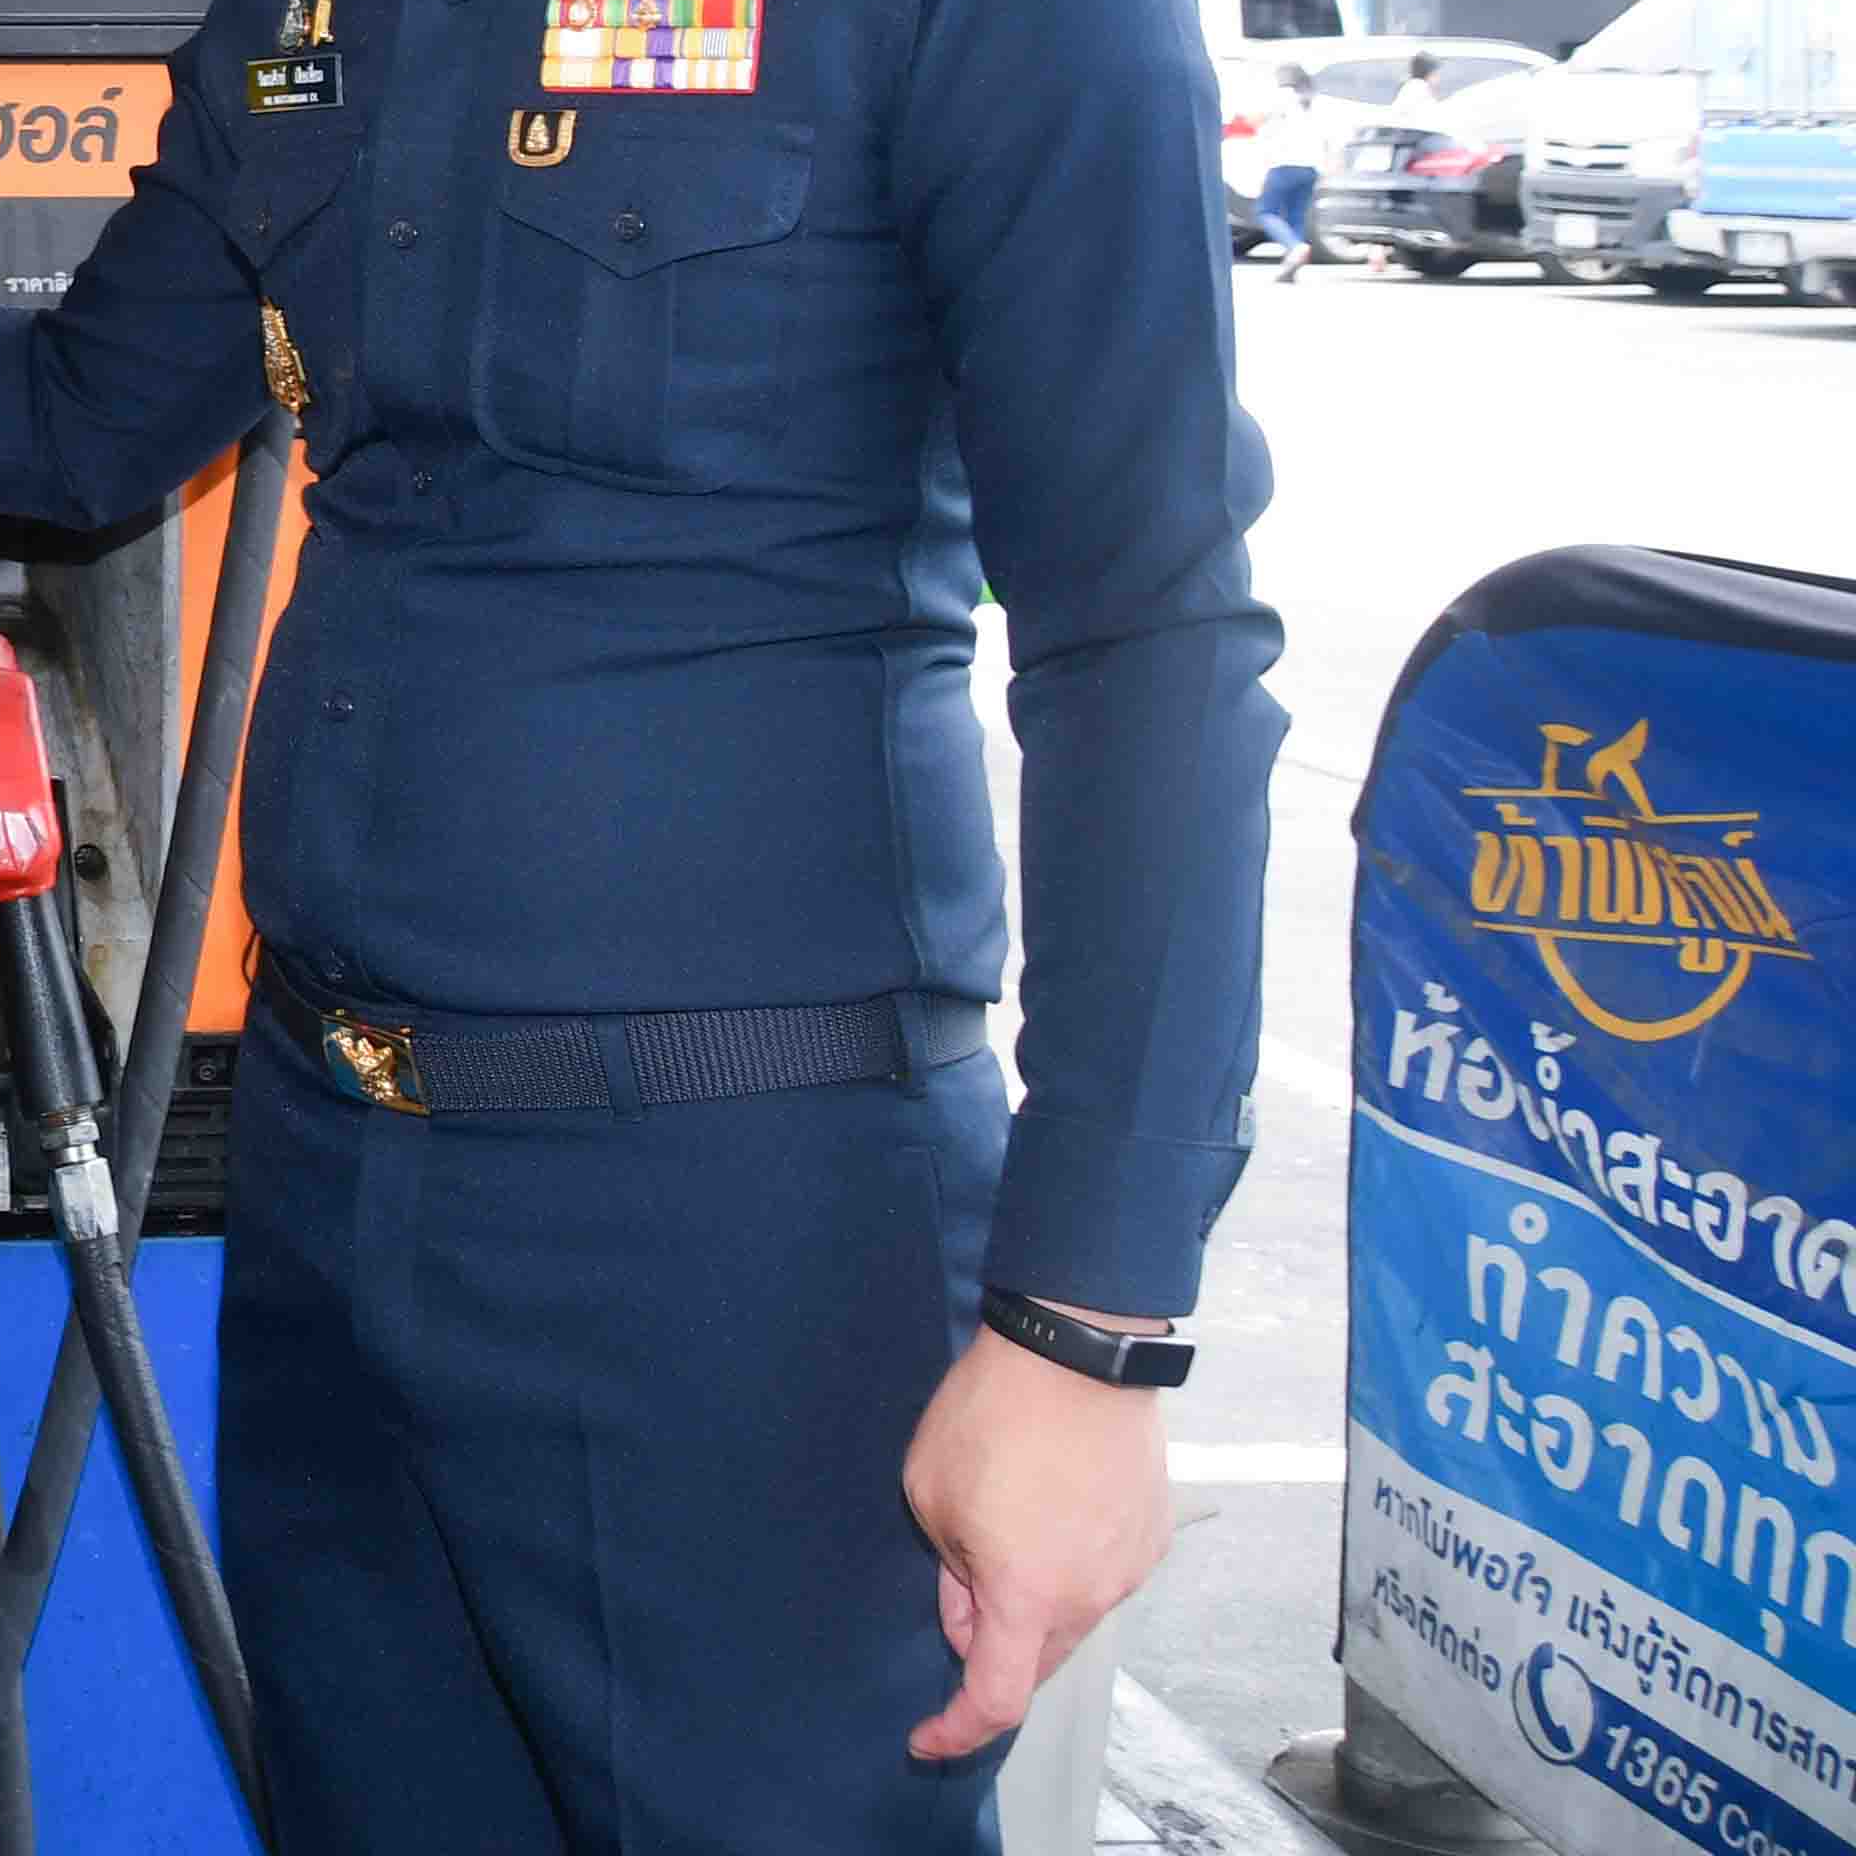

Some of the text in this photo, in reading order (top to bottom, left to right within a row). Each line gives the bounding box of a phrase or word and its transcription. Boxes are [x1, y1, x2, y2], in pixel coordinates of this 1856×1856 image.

[1468, 1202, 1837, 1487] ทำความ
[1374, 1476, 1553, 1616] หากไม่พอใจ
[1604, 1724, 1720, 1825] 1365
